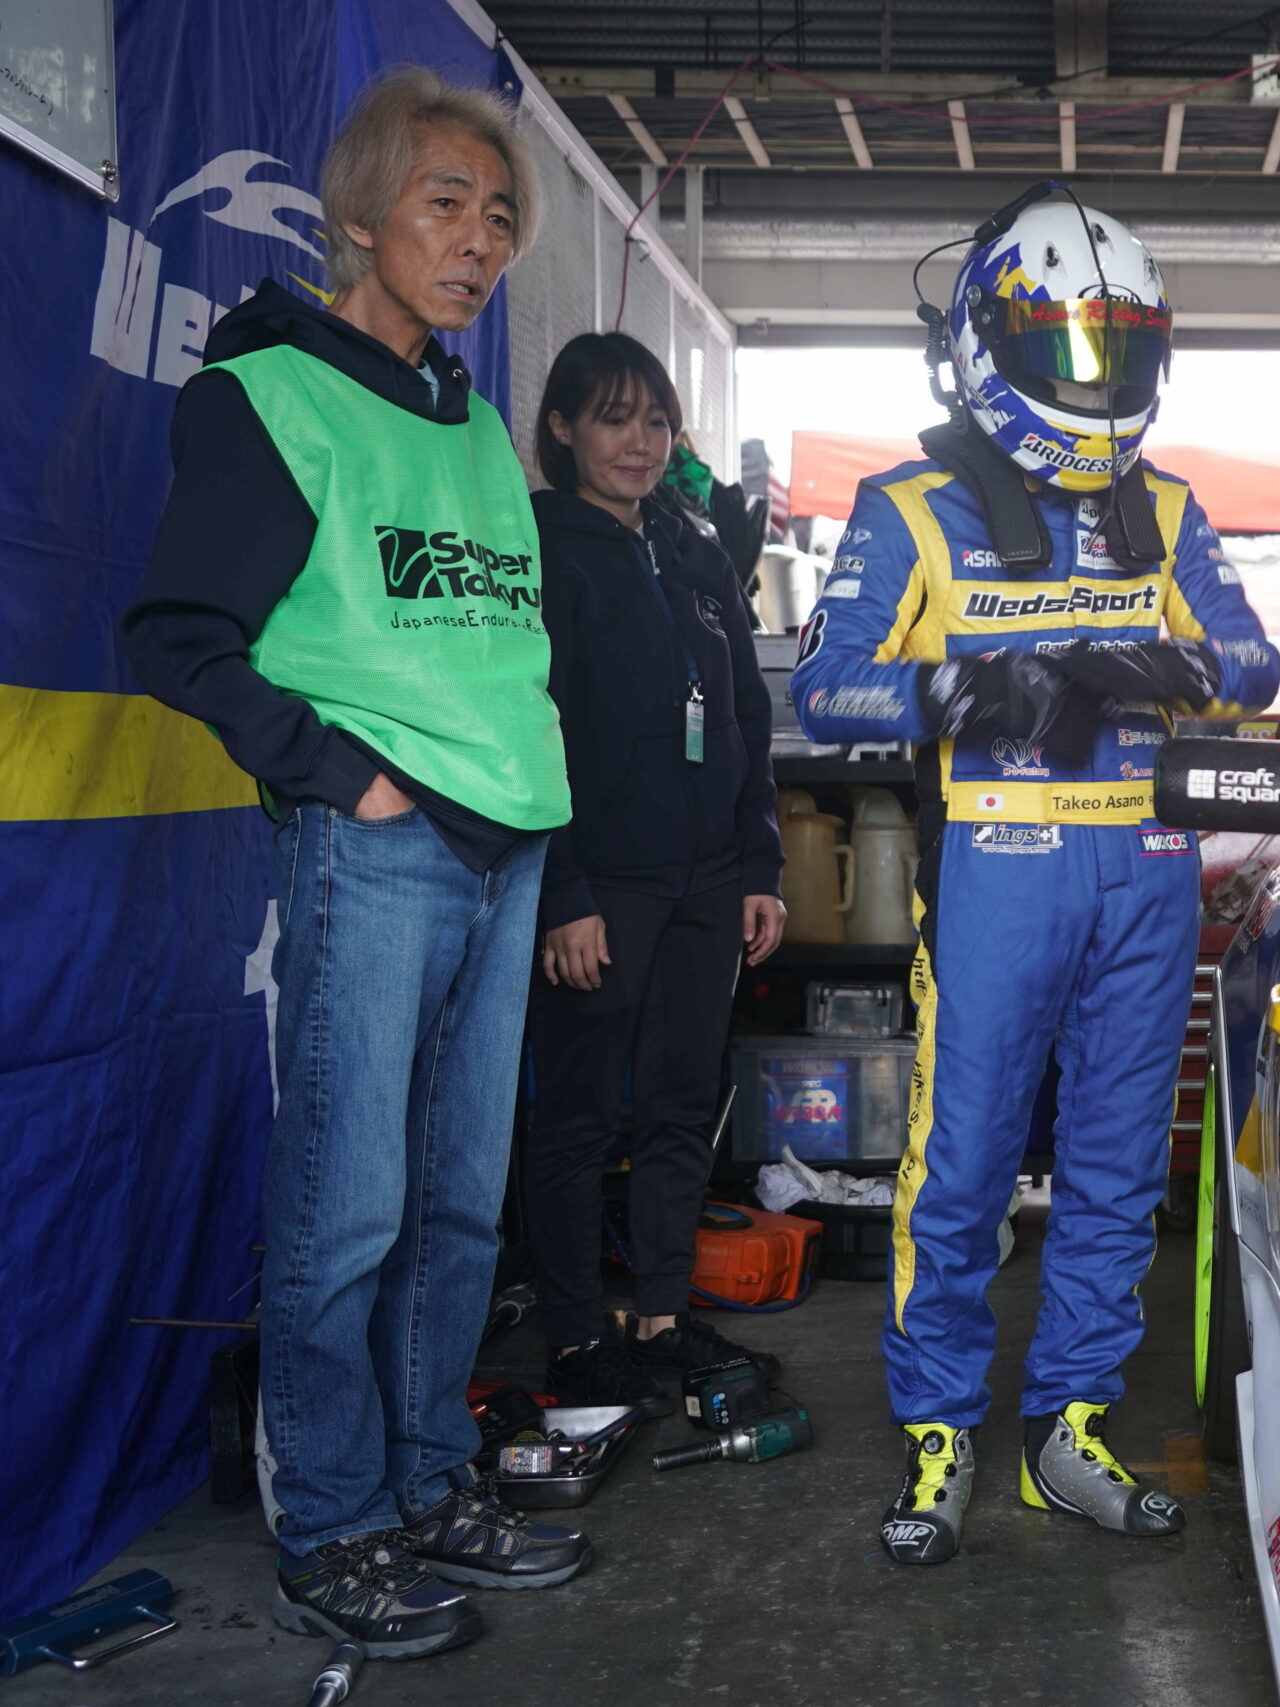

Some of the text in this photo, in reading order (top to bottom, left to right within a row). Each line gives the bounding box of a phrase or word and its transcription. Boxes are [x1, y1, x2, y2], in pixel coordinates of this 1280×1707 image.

[429, 531, 532, 576] Super
[437, 565, 541, 611] Taikyu
[962, 583, 1158, 620] WedsSport
[391, 611, 466, 630] Japanese
[1219, 767, 1275, 787] craft
[1052, 794, 1101, 811] Takeo
[1104, 795, 1144, 809] Asano
[882, 1524, 930, 1541] OMP
